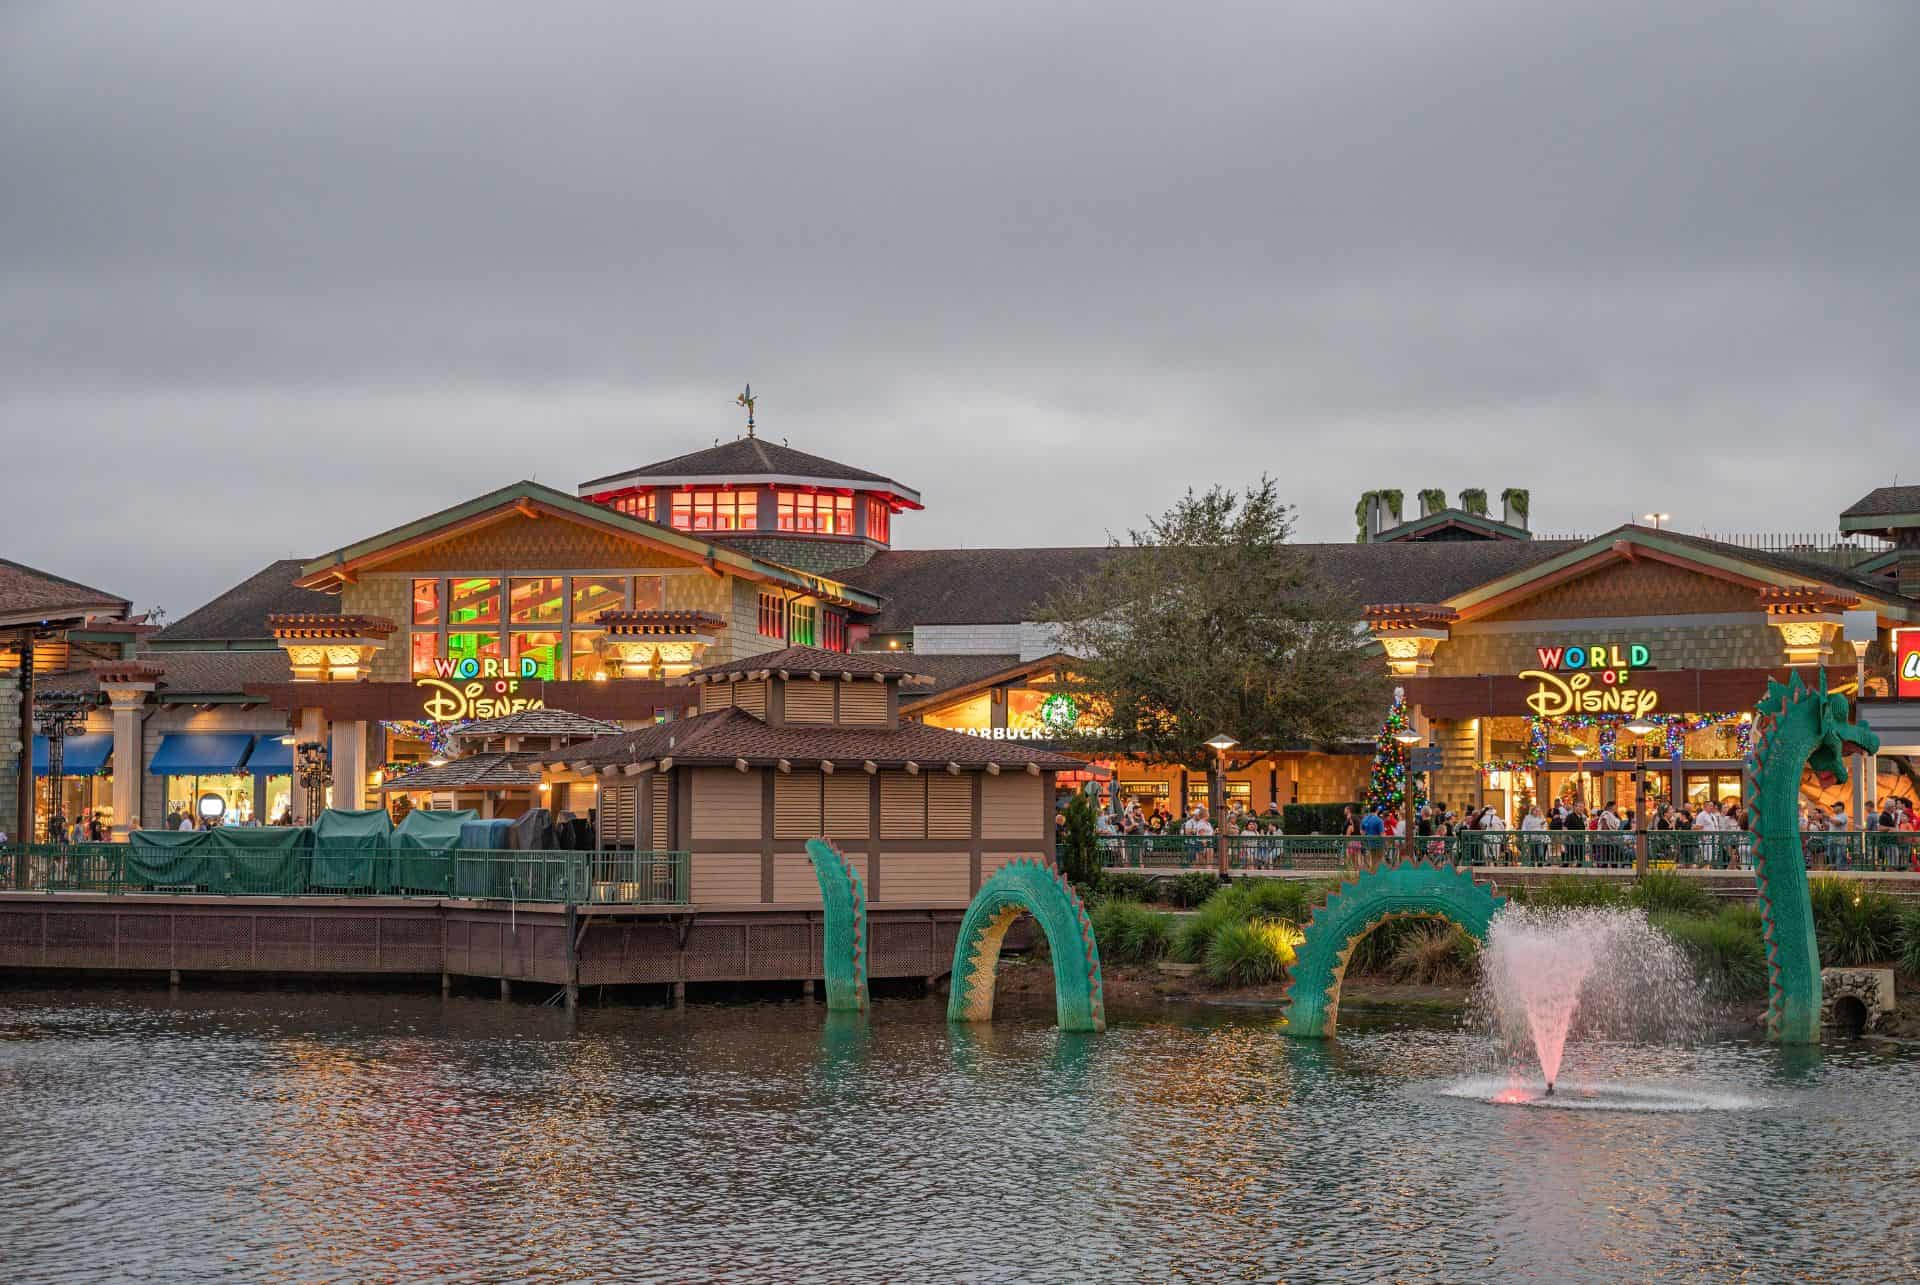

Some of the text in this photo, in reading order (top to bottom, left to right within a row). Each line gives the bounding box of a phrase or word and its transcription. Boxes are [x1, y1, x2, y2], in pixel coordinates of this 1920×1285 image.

[1537, 645, 1649, 669] WORLD
[434, 658, 537, 678] WORLD
[1602, 671, 1629, 685] OF
[495, 681, 519, 693] OF
[945, 727, 1055, 740] TARBUCKS
